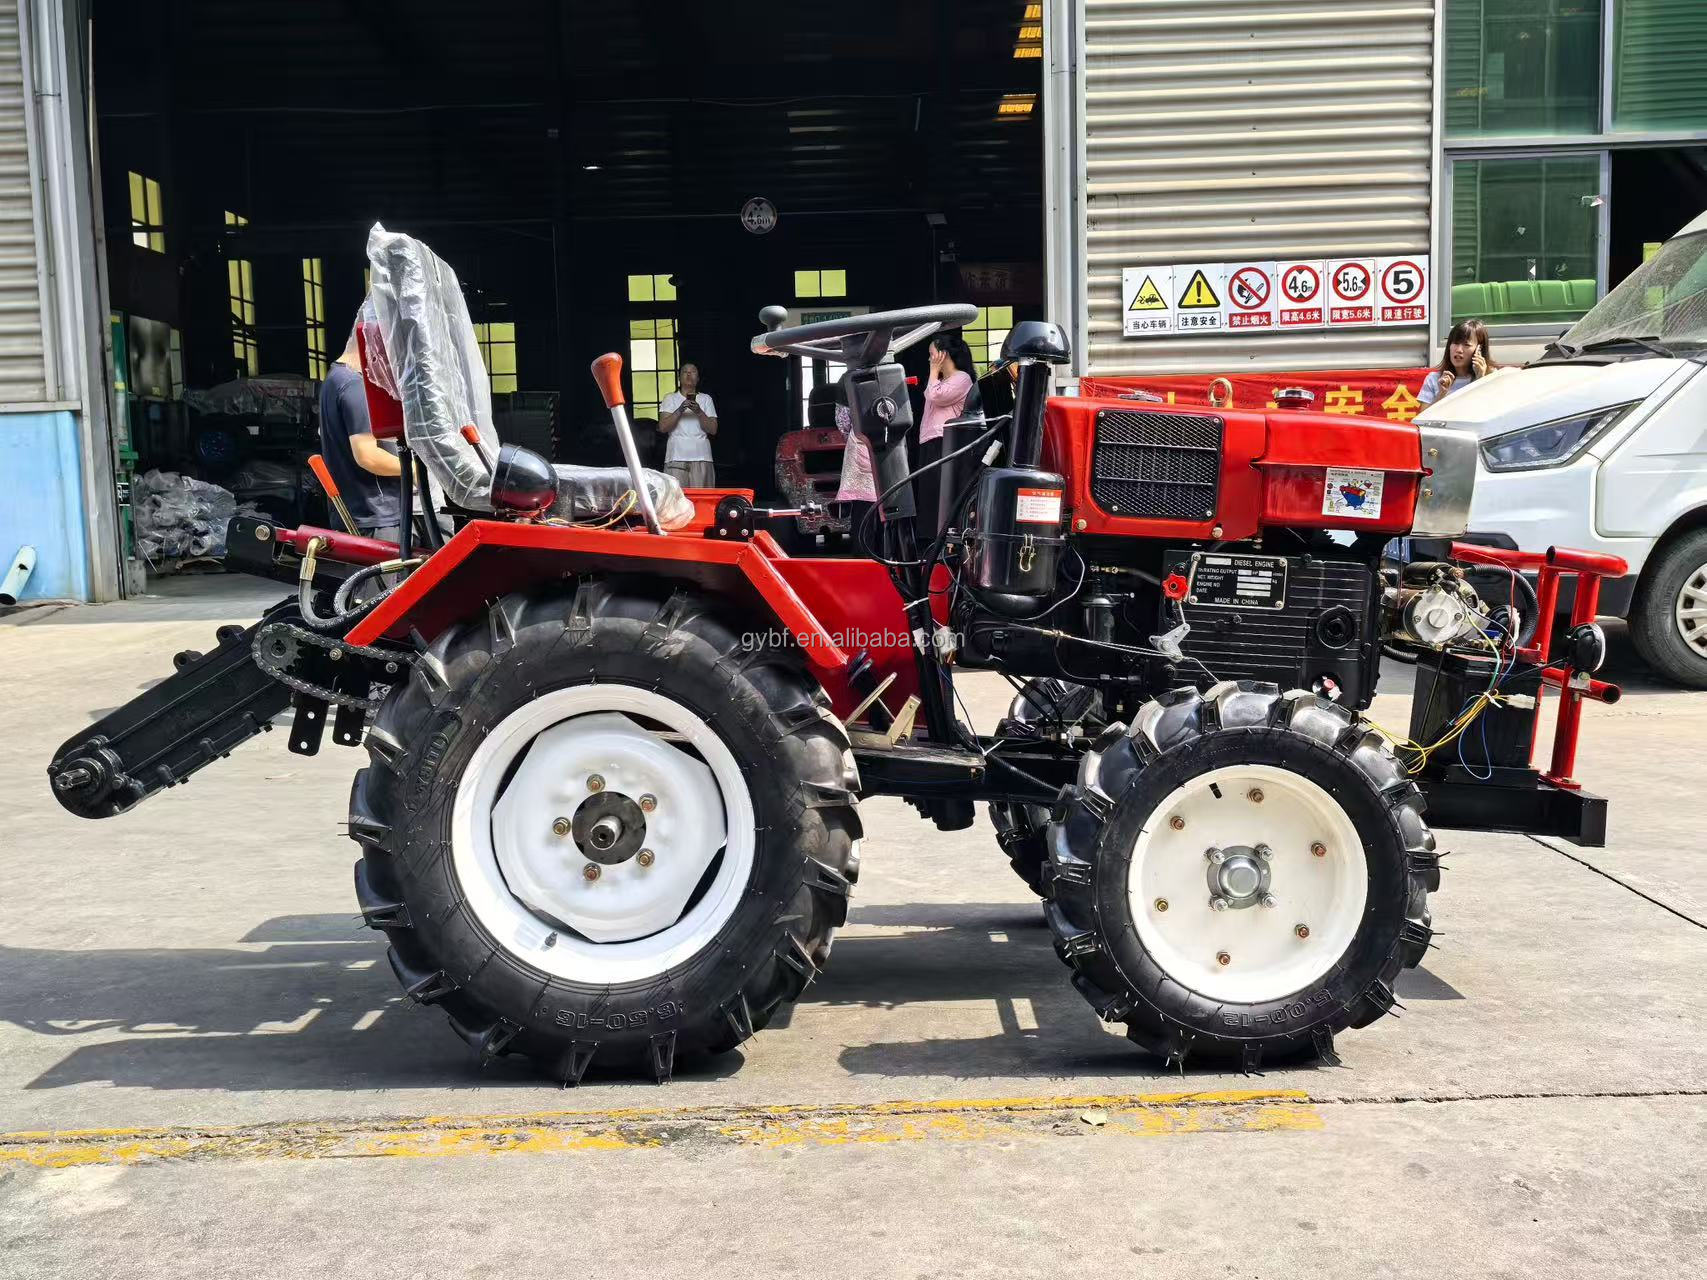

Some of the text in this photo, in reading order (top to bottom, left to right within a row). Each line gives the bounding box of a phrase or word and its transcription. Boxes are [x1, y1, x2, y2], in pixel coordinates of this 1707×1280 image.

[1288, 276, 1313, 293] 4.6m
[1342, 272, 1363, 292] 5.6m
[1393, 270, 1414, 295] 5
[1281, 309, 1320, 322] 限高4.6米
[1332, 308, 1372, 320] 限宽5.6米
[1384, 307, 1424, 320] 限速行驶
[1132, 319, 1167, 330] 当心车辆
[1181, 315, 1217, 326] 注意安全
[1231, 314, 1269, 327] 禁止烟火
[1234, 559, 1275, 568] DIESEL ENGINE
